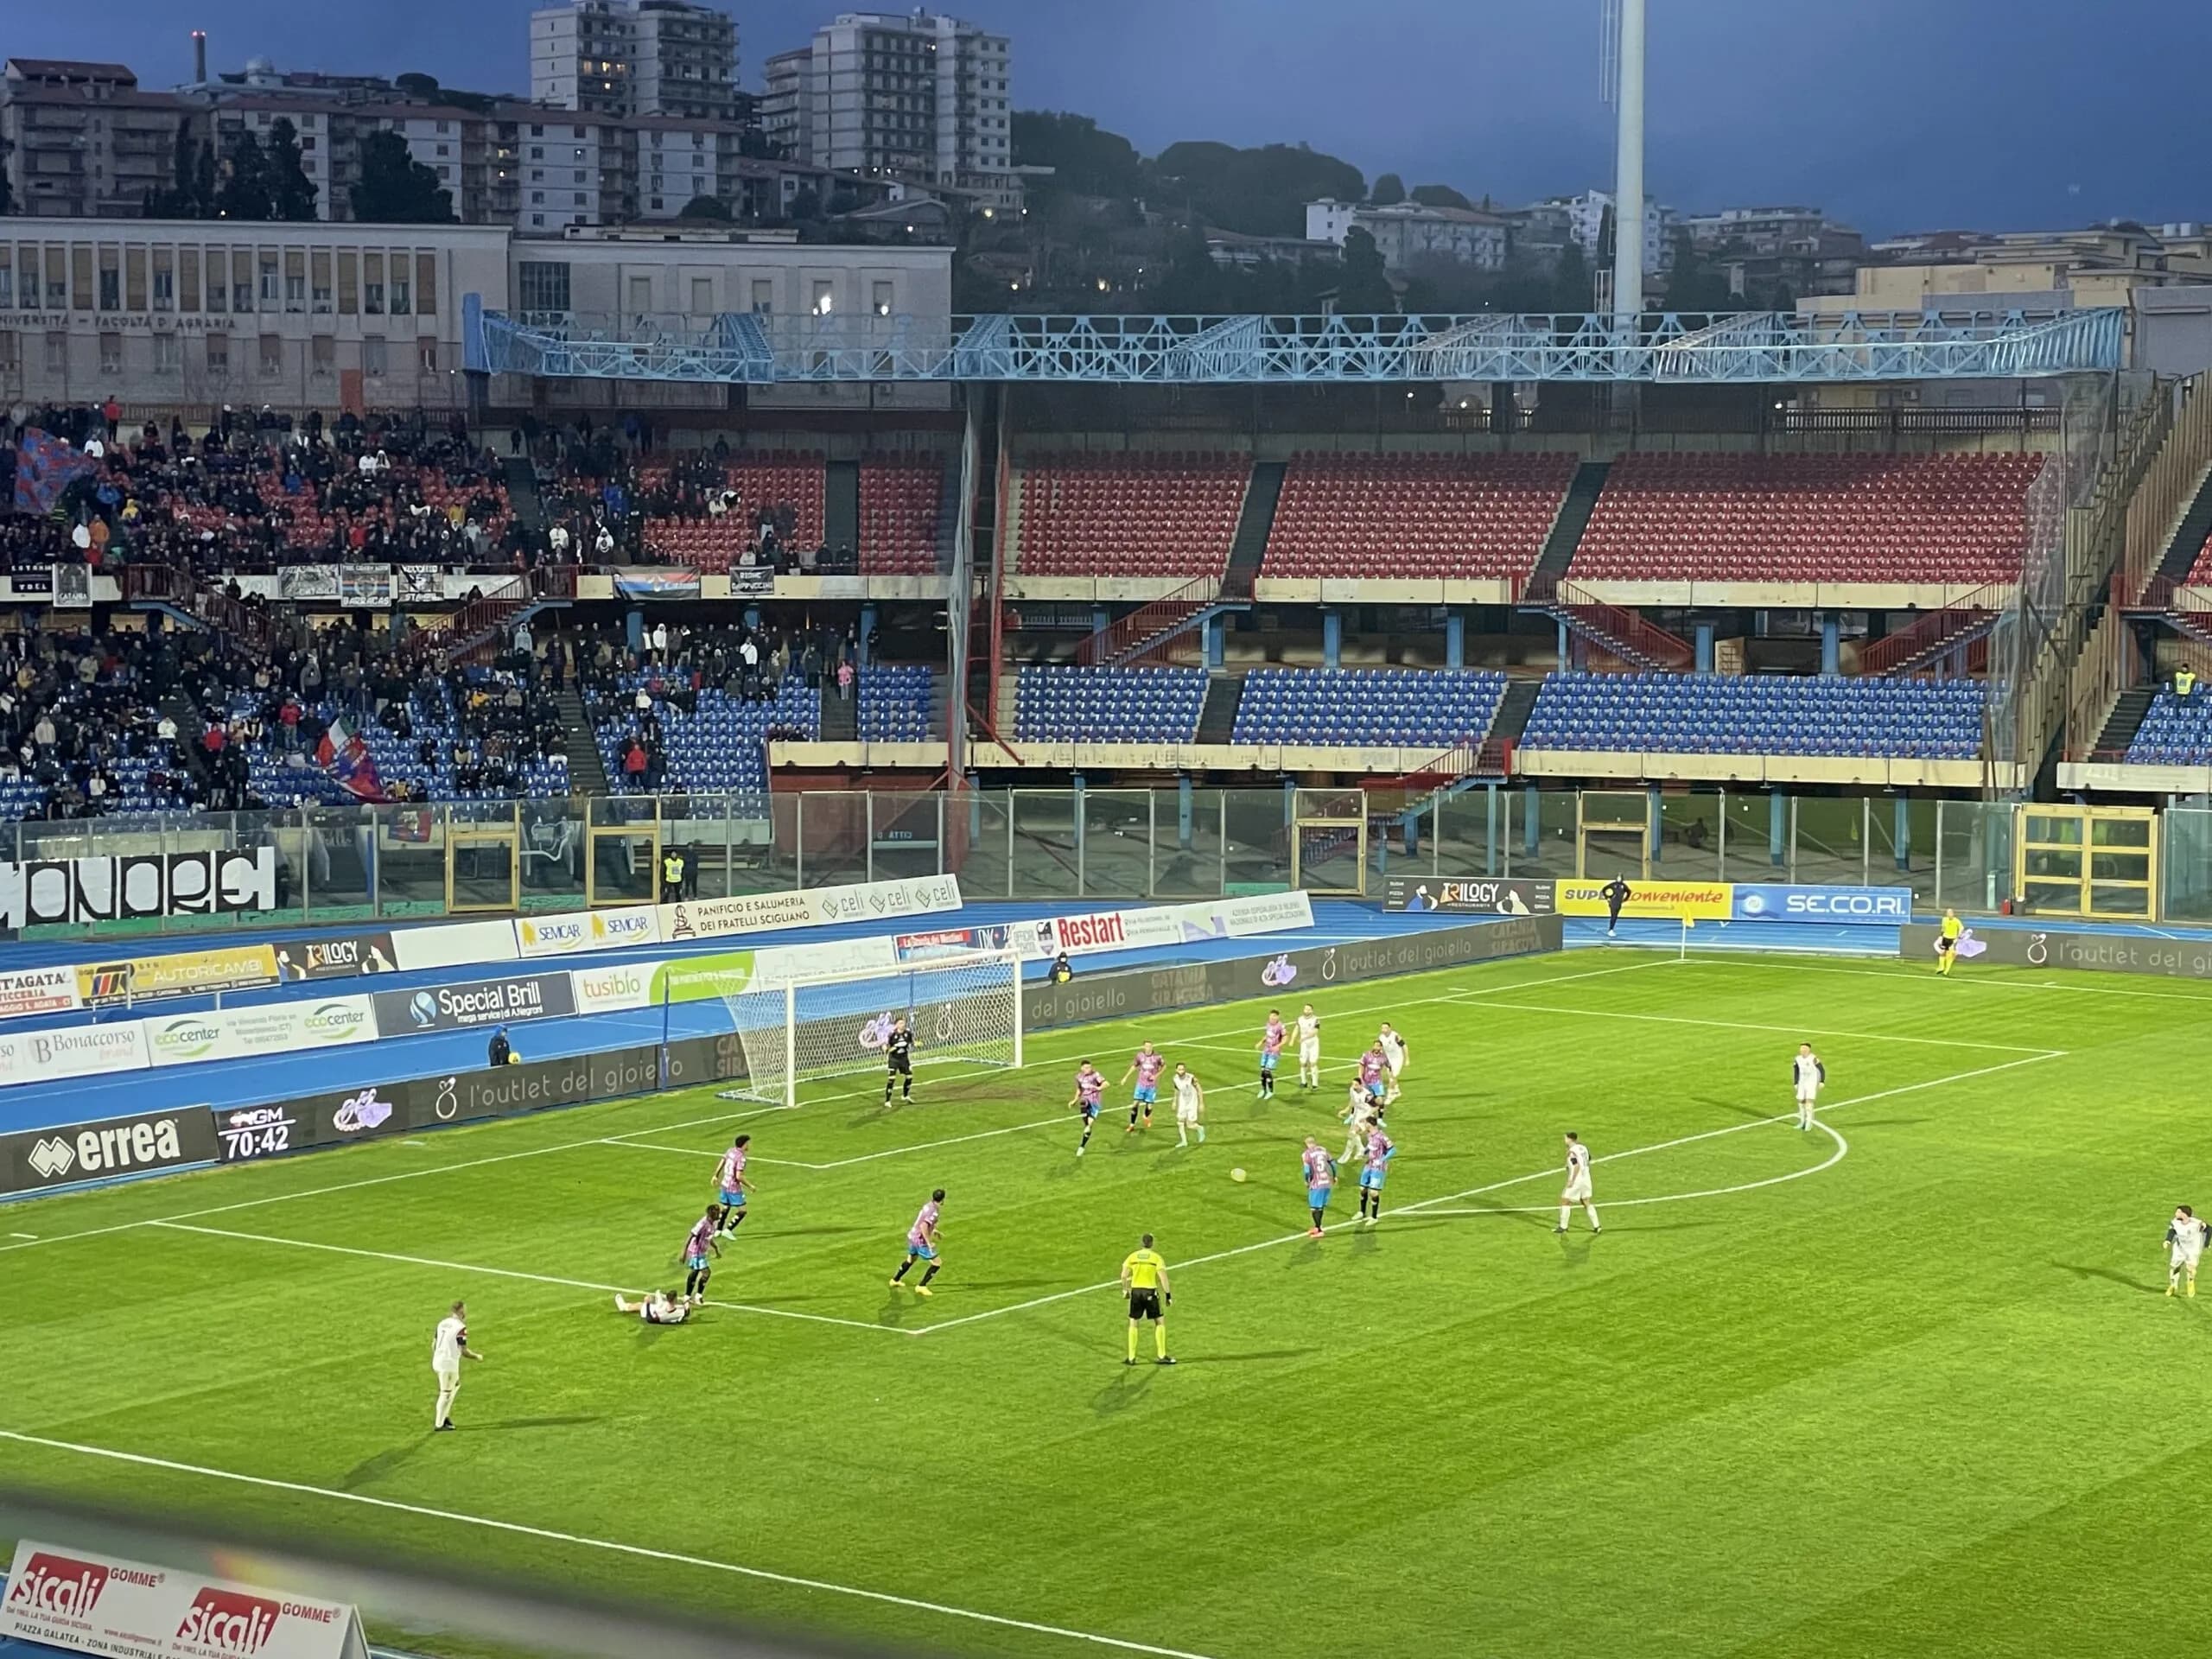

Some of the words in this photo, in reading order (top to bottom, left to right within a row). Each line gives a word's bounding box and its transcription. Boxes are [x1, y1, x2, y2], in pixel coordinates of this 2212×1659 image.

[175, 318, 235, 328] AGRARIA
[343, 596, 389, 606] BARRACAS
[841, 889, 865, 912] celi
[887, 884, 911, 906] celi
[932, 879, 956, 901] celi
[1440, 883, 1499, 904] TRILOGY
[1630, 889, 1723, 903] onveniente
[697, 902, 743, 917] PANIFICIO
[746, 901, 752, 912] E
[753, 897, 805, 911] SALUMERIA
[1786, 893, 1906, 916] SE.CO.RI.
[700, 921, 715, 931] DEI
[718, 917, 757, 931] FRATELLI
[760, 911, 810, 925] SCIGLIANO
[1057, 912, 1125, 948] Restart
[305, 941, 359, 969] TRILOGY
[1342, 950, 1394, 974] l'outlet
[1397, 944, 1421, 964] del
[1424, 938, 1472, 964] gioiello
[2059, 941, 2138, 964] l'outlet
[2149, 948, 2183, 969] del
[153, 959, 264, 983] AUTORICAMBI
[439, 985, 505, 1017] Special
[506, 981, 542, 1007] Brill
[1032, 994, 1062, 1020] del
[1065, 990, 1126, 1021] gioiello
[304, 1010, 365, 1028] ecocenter
[54, 1029, 136, 1052] Bonaccorso
[156, 1027, 220, 1046] ecocenter
[469, 1073, 551, 1109] l'outlet
[561, 1068, 595, 1095] del
[226, 1125, 289, 1160] 70:42
[1316, 1154, 1325, 1173] 5
[13, 1567, 100, 1618] sicali
[177, 1602, 272, 1654] sicali
[14, 1623, 41, 1636] PIAZZA
[43, 1629, 79, 1643] GALATEA
[86, 1638, 108, 1650] ZONA
[111, 1643, 162, 1659] INDUSTRIALE
